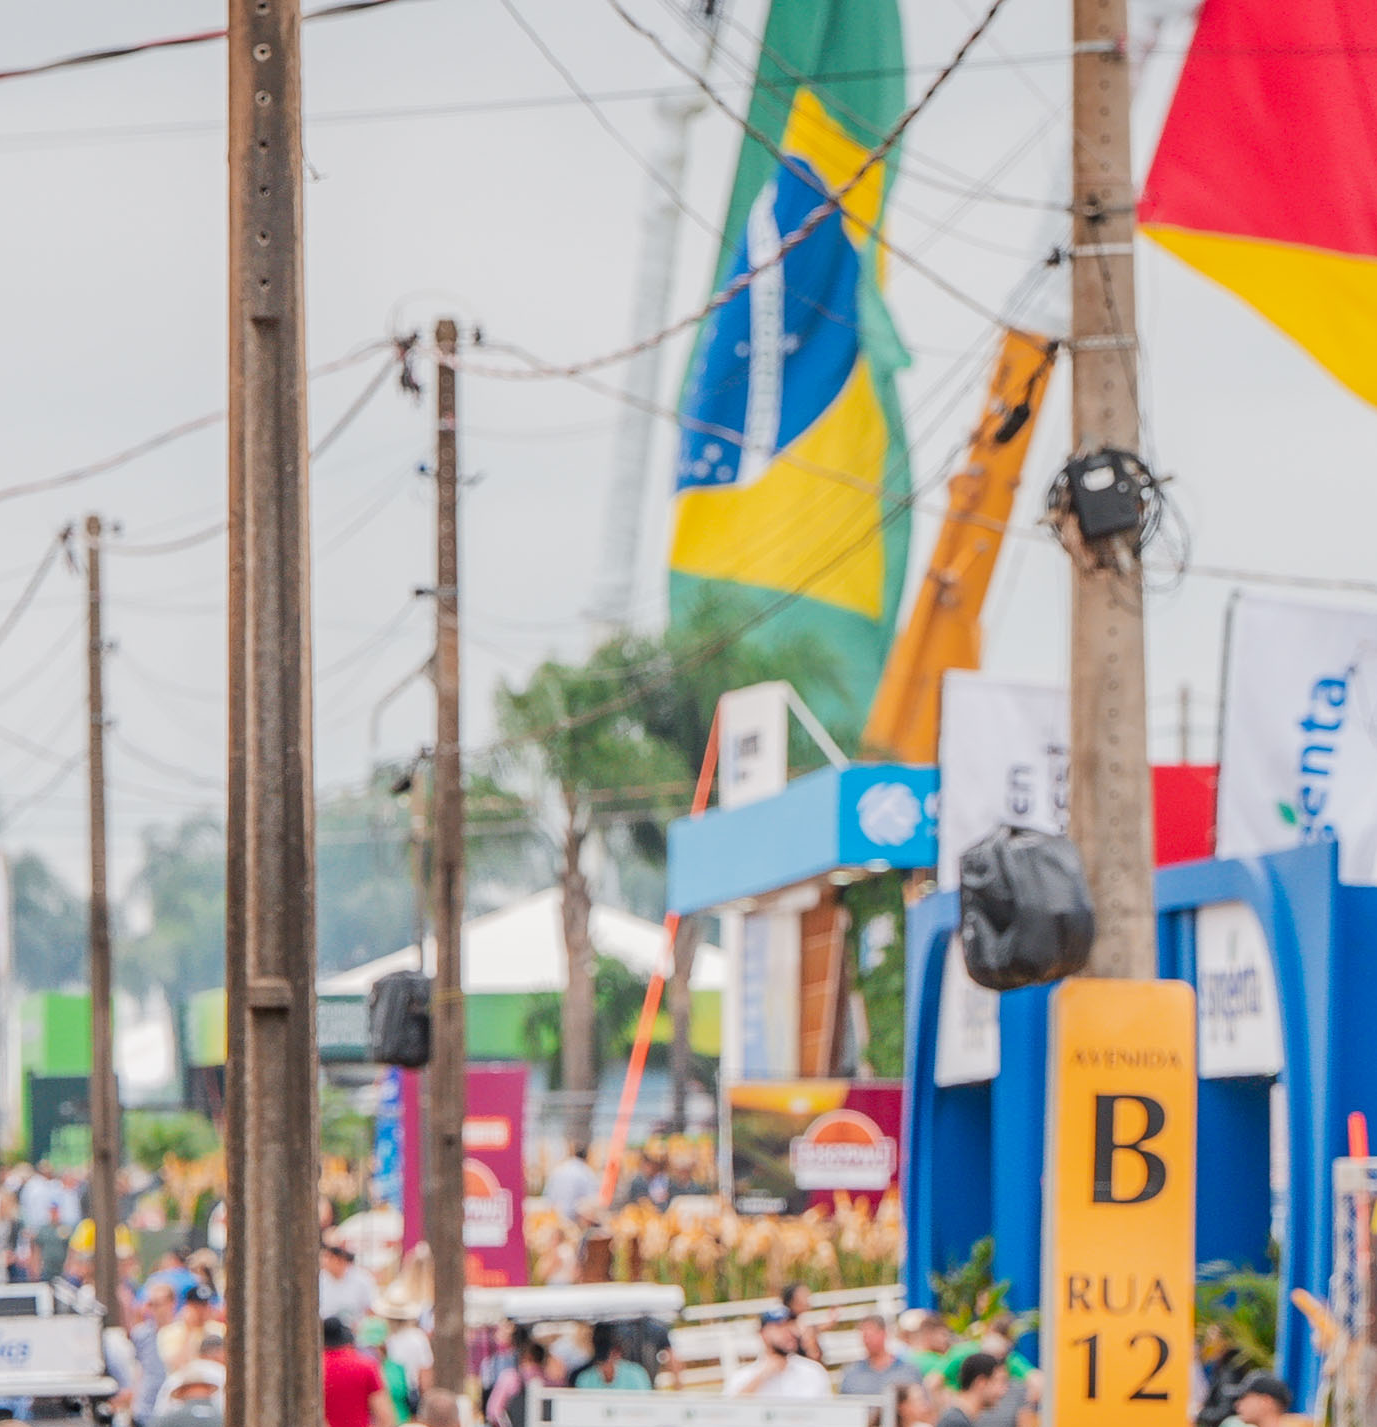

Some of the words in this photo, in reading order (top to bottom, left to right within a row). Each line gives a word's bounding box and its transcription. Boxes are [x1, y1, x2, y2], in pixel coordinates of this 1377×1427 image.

[1300, 677, 1348, 842] enta
[1070, 1048, 1183, 1070] AVENIDA
[1092, 1093, 1167, 1204] B
[1068, 1274, 1173, 1313] RUA
[1072, 1333, 1170, 1401] 12
